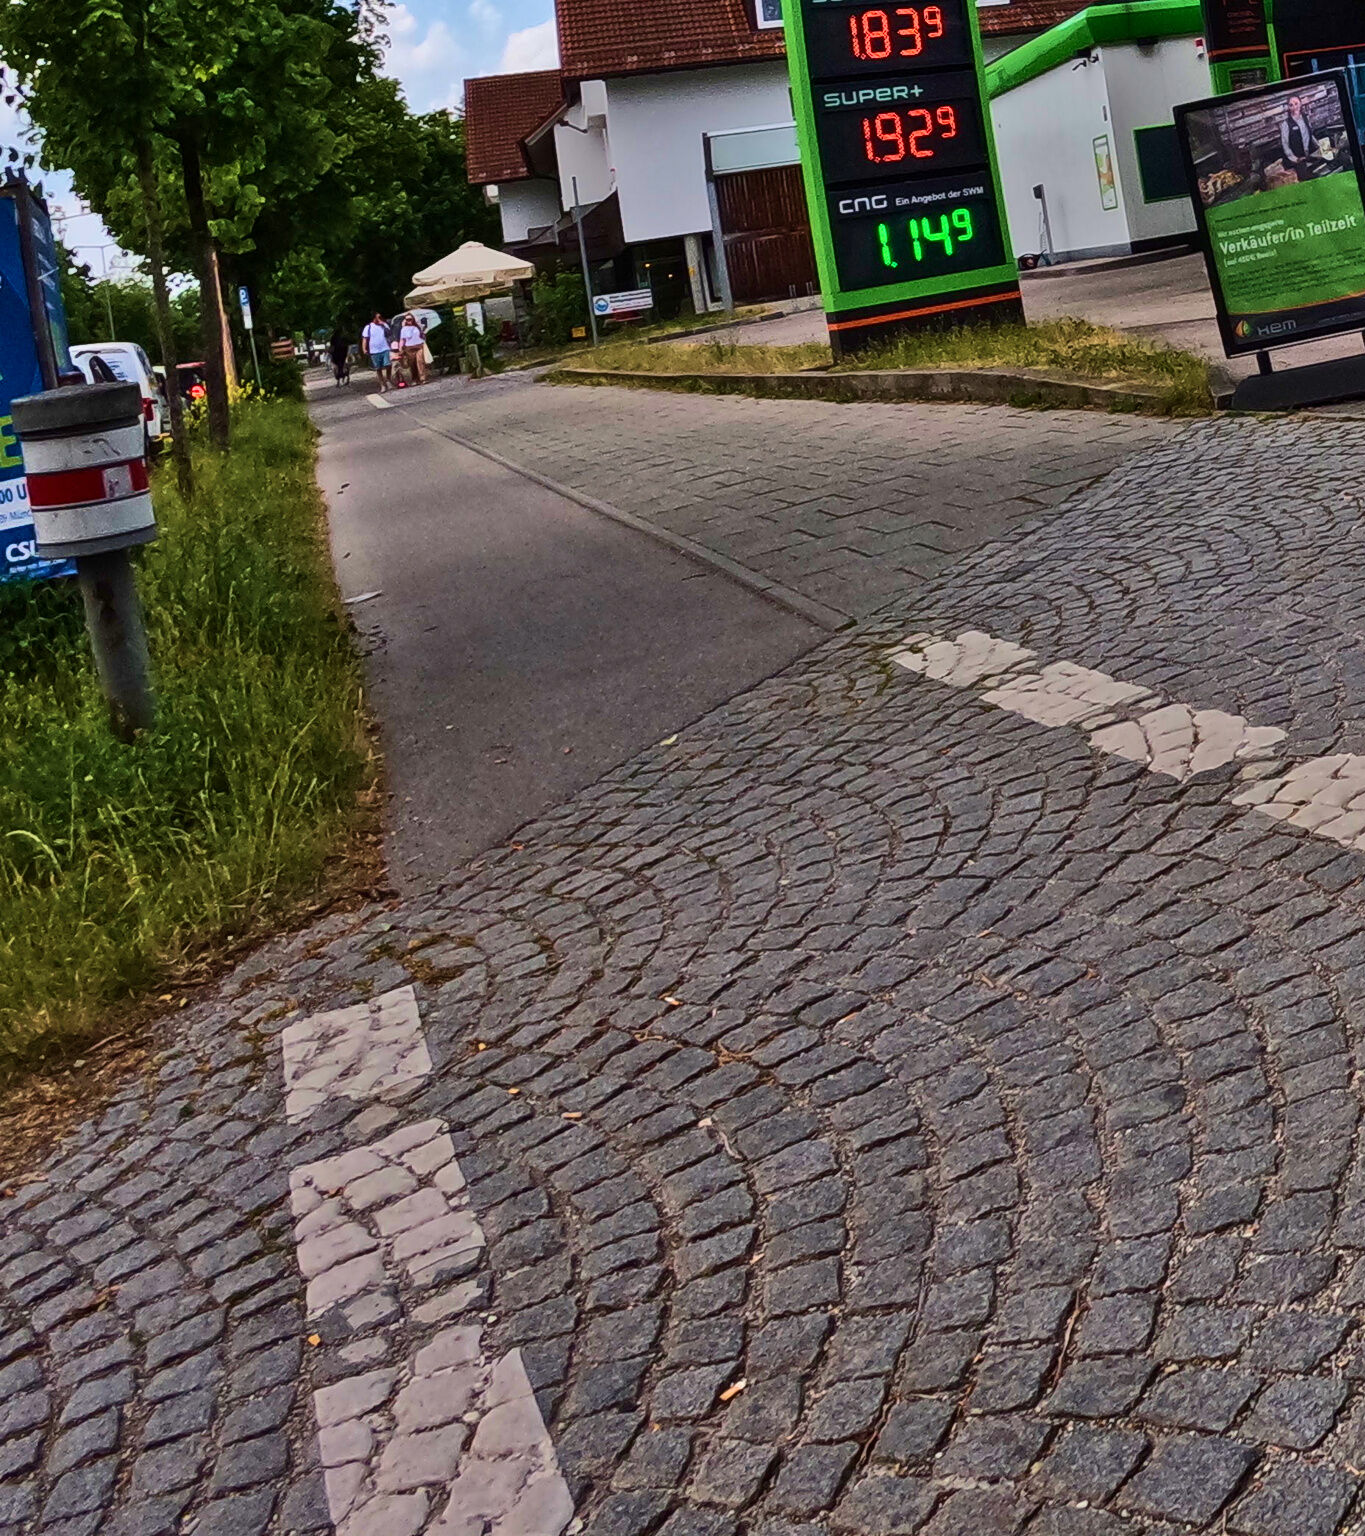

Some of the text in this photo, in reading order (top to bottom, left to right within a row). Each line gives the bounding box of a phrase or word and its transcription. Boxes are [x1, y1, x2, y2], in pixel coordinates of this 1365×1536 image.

[823, 84, 924, 107] SUPER+
[838, 194, 888, 214] CNG
[895, 197, 910, 207] Ein
[911, 191, 946, 205] Angebot
[948, 189, 961, 199] der
[1306, 214, 1357, 237] Teilzeit
[1257, 319, 1297, 336] HEM
